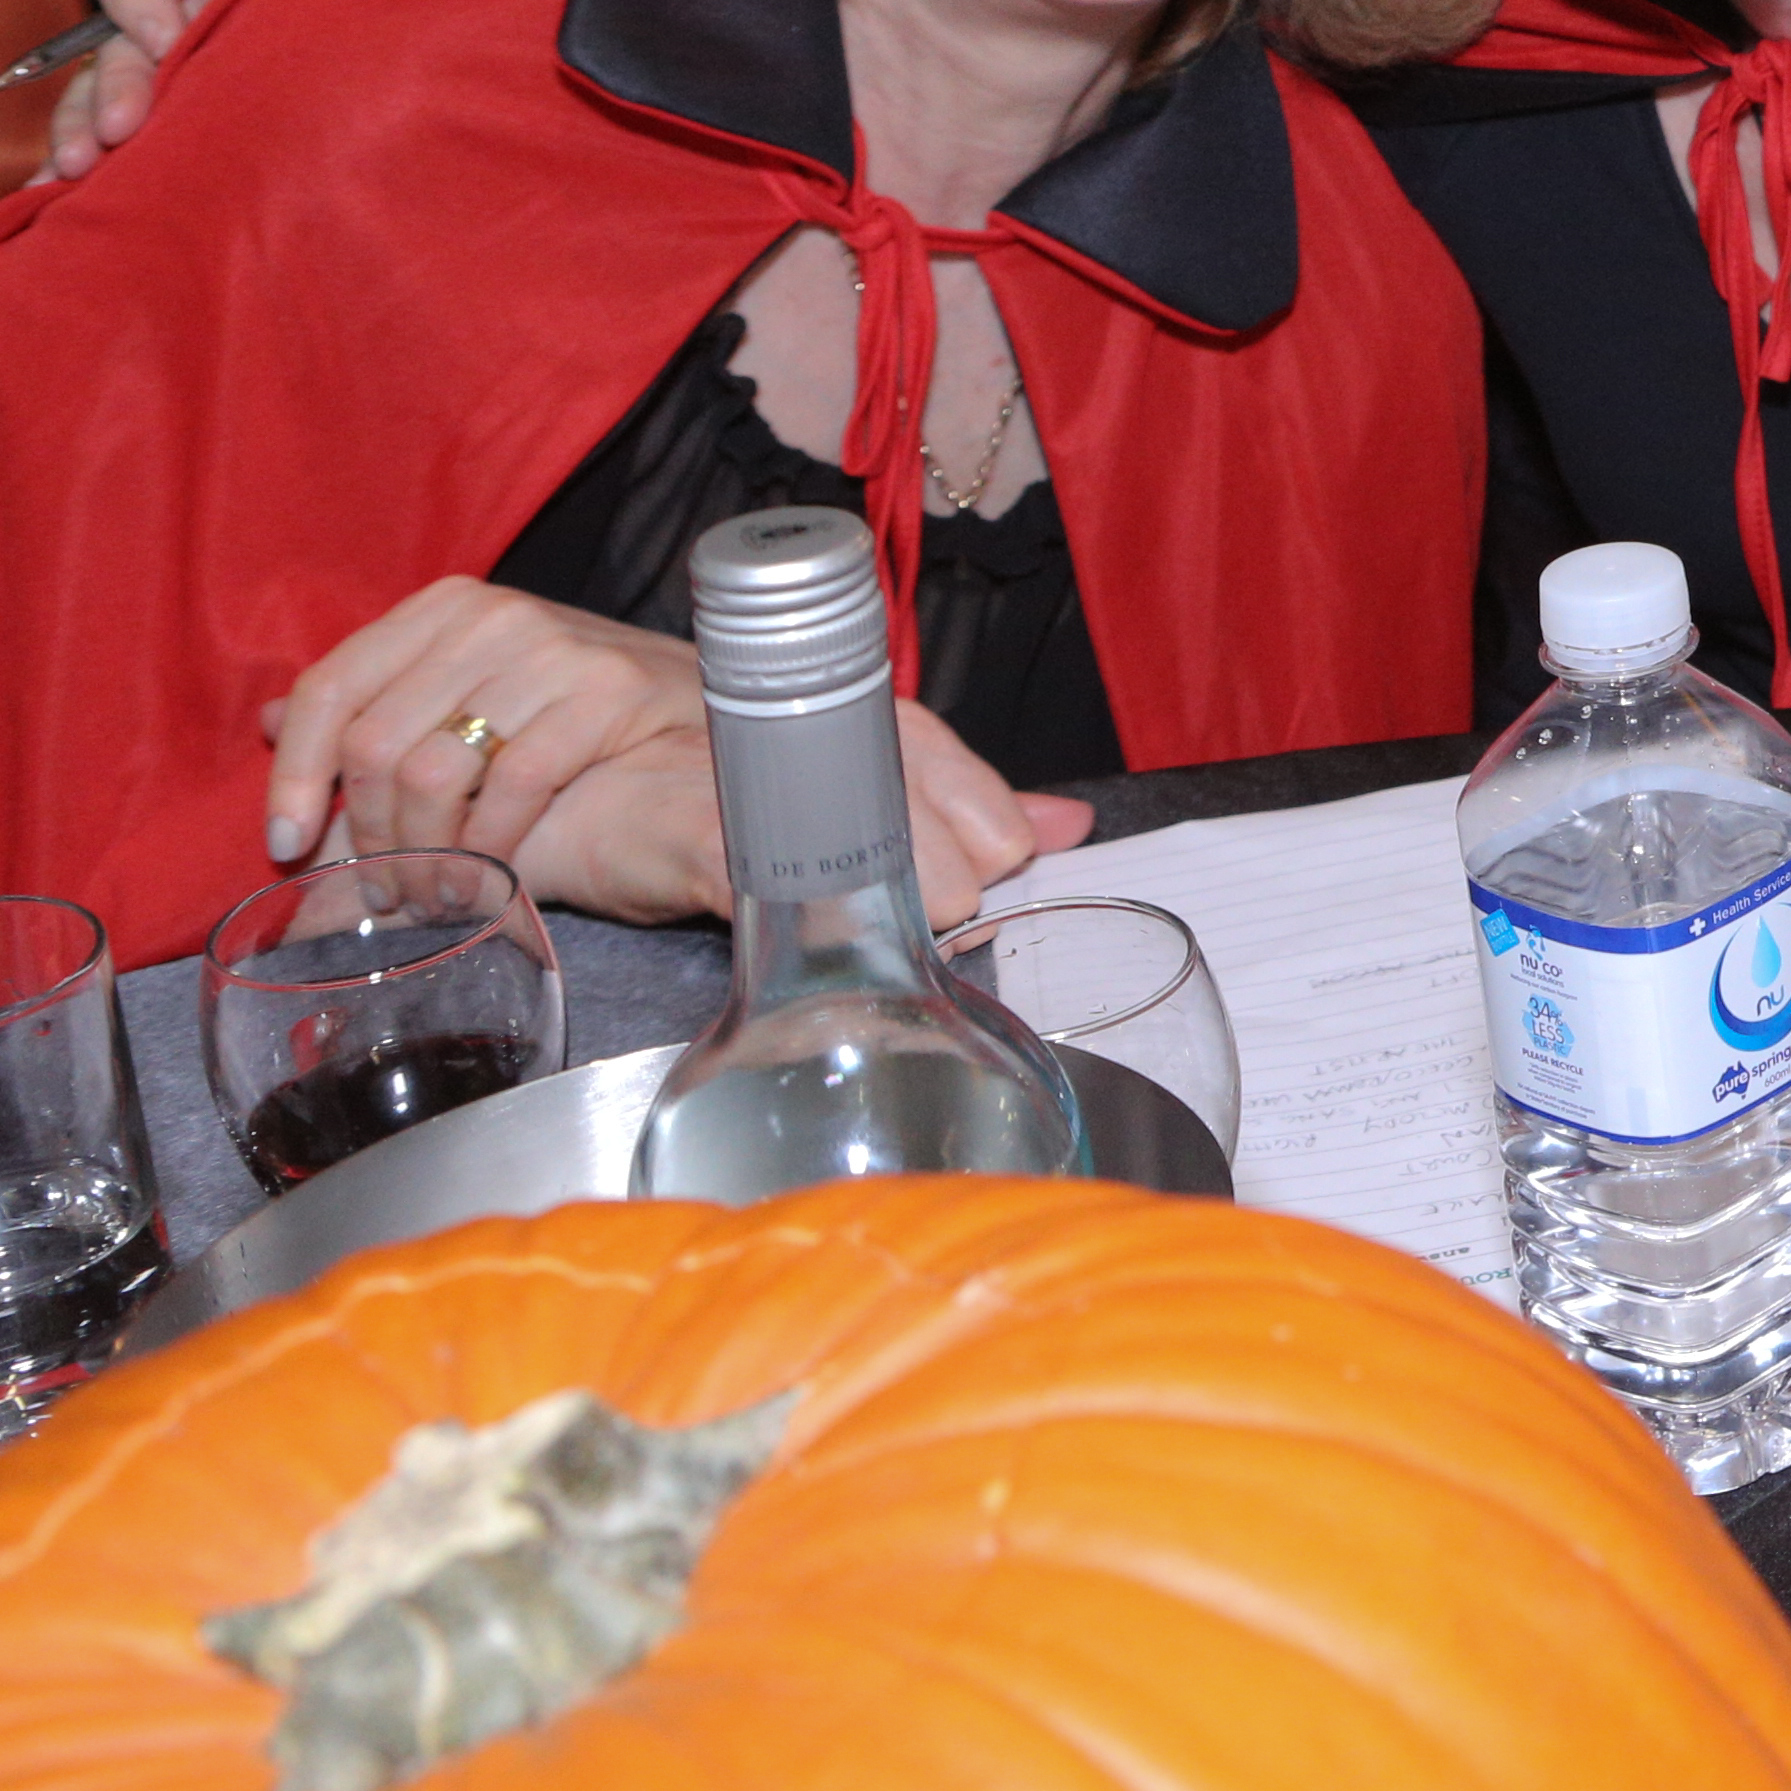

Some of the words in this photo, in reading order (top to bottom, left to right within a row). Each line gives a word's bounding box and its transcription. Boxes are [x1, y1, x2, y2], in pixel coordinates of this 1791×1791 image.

[771, 861, 804, 878] DE
[819, 833, 898, 875] BORTO
[1712, 895, 1751, 924] Health
[1520, 953, 1539, 970] nu
[1757, 985, 1785, 1017] nu
[1532, 1019, 1565, 1045] LESS
[1522, 1047, 1549, 1064] PLEASE
[1550, 1057, 1584, 1076] RECYCLE
[1714, 1071, 1750, 1098] pure
[1751, 1045, 1791, 1078] spring
[1764, 1064, 1791, 1088] 600ml
[1459, 1266, 1512, 1287] ROU
